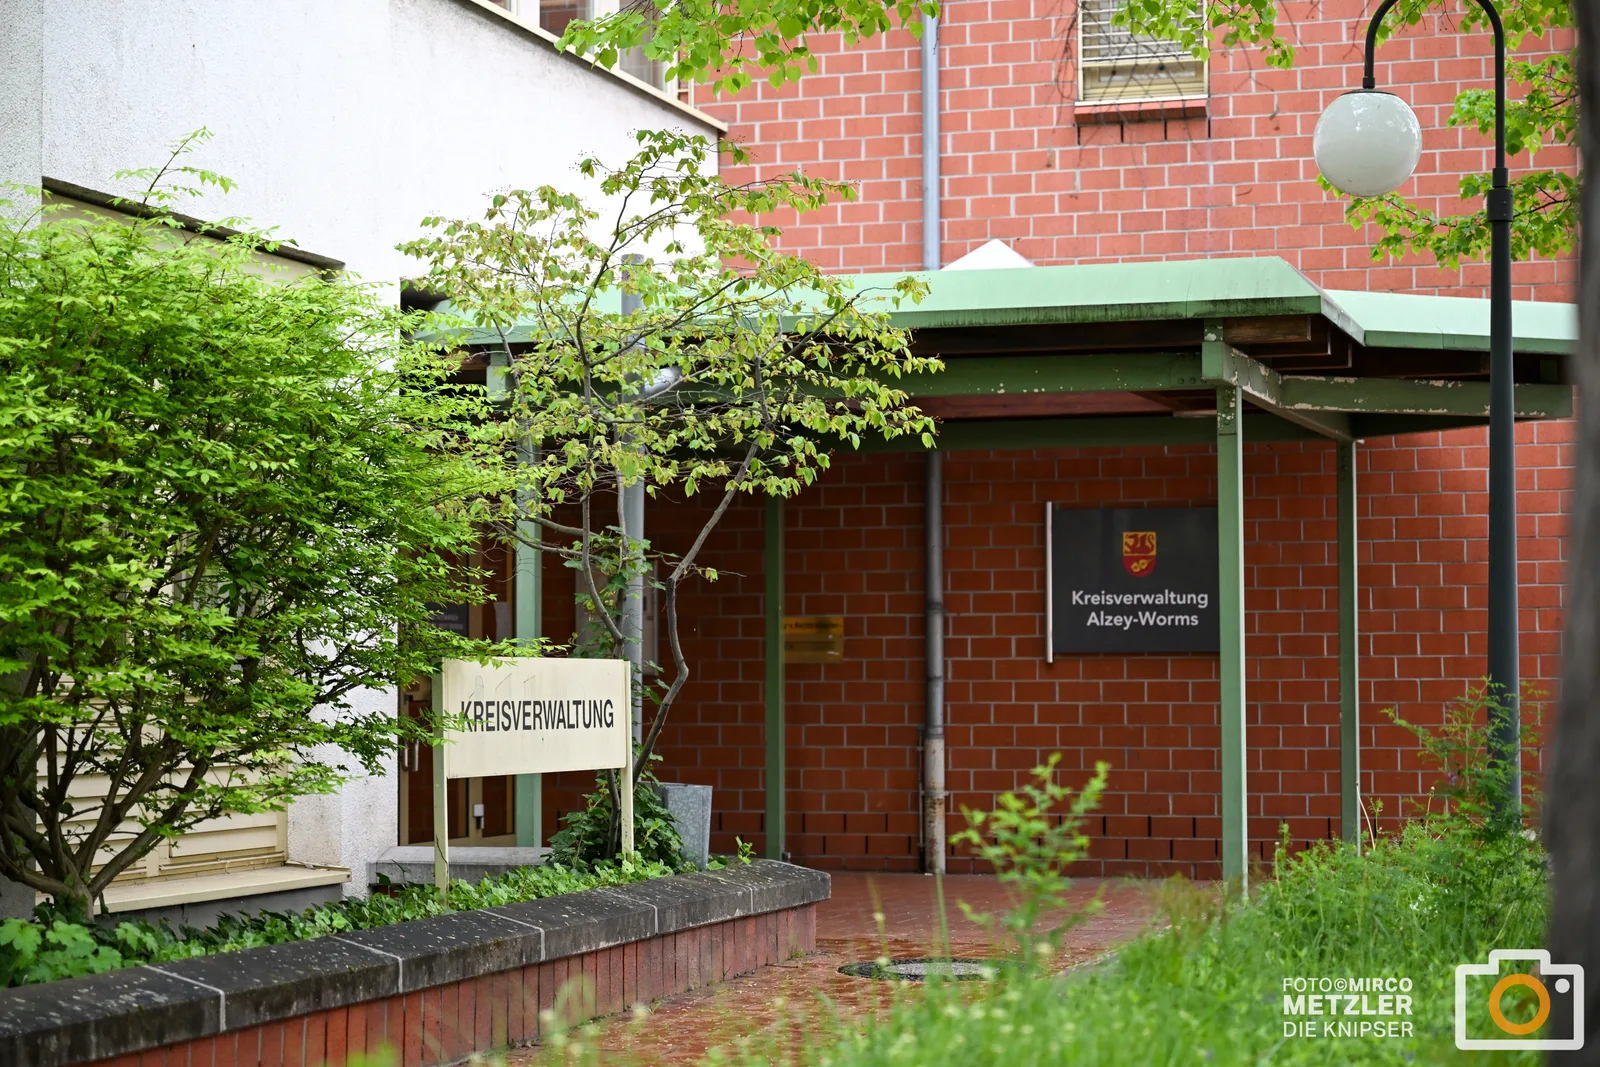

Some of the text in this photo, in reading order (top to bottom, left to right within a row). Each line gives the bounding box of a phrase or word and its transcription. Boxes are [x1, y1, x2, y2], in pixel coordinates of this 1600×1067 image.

[1071, 589, 1209, 609] Kreisverwaltung
[1086, 610, 1199, 630] Alzey-Worms
[460, 699, 614, 733] KREISVERWALTUNG
